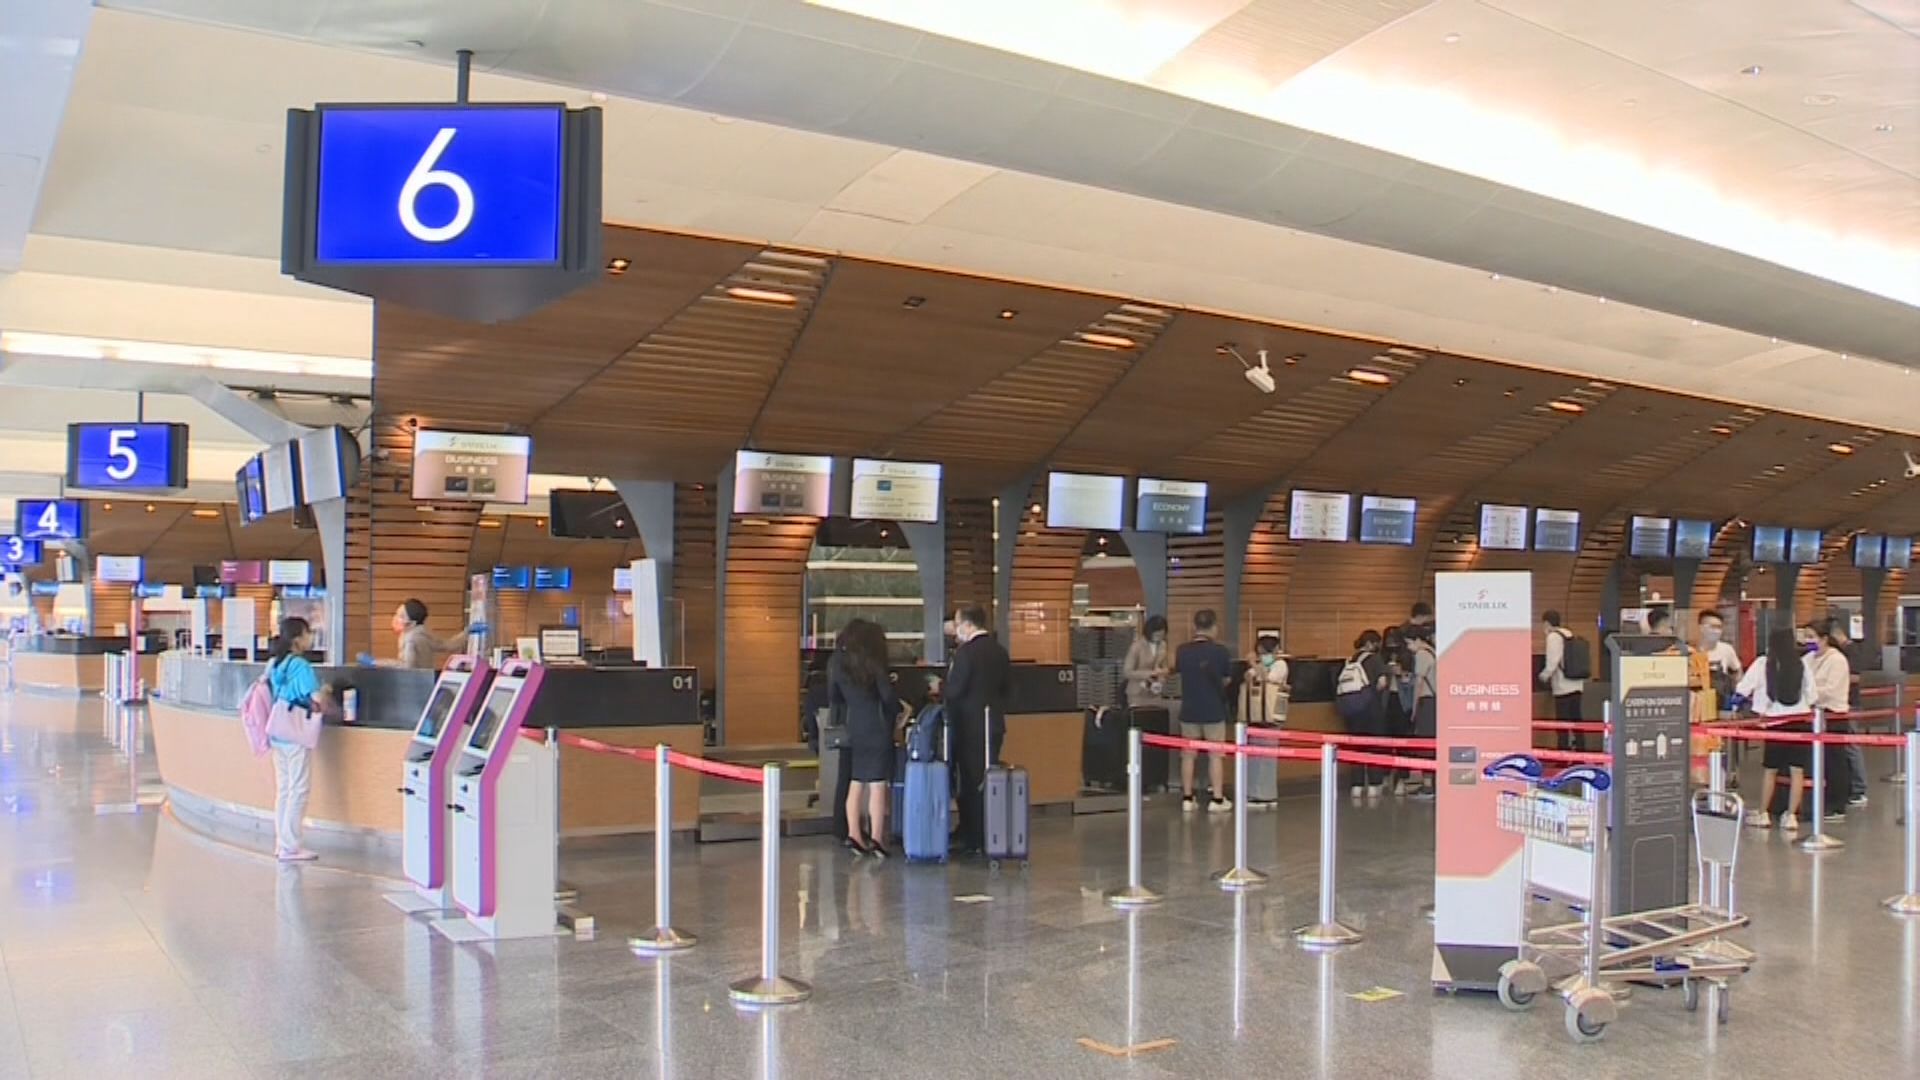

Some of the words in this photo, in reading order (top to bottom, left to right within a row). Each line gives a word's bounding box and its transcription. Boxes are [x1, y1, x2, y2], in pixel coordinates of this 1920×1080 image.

[398, 127, 475, 242] 6
[106, 430, 138, 480] 5
[37, 501, 60, 533] 4
[7, 536, 24, 560] 3
[672, 675, 693, 690] 01
[1058, 670, 1074, 682] 03
[1449, 684, 1520, 695] BUSINESS
